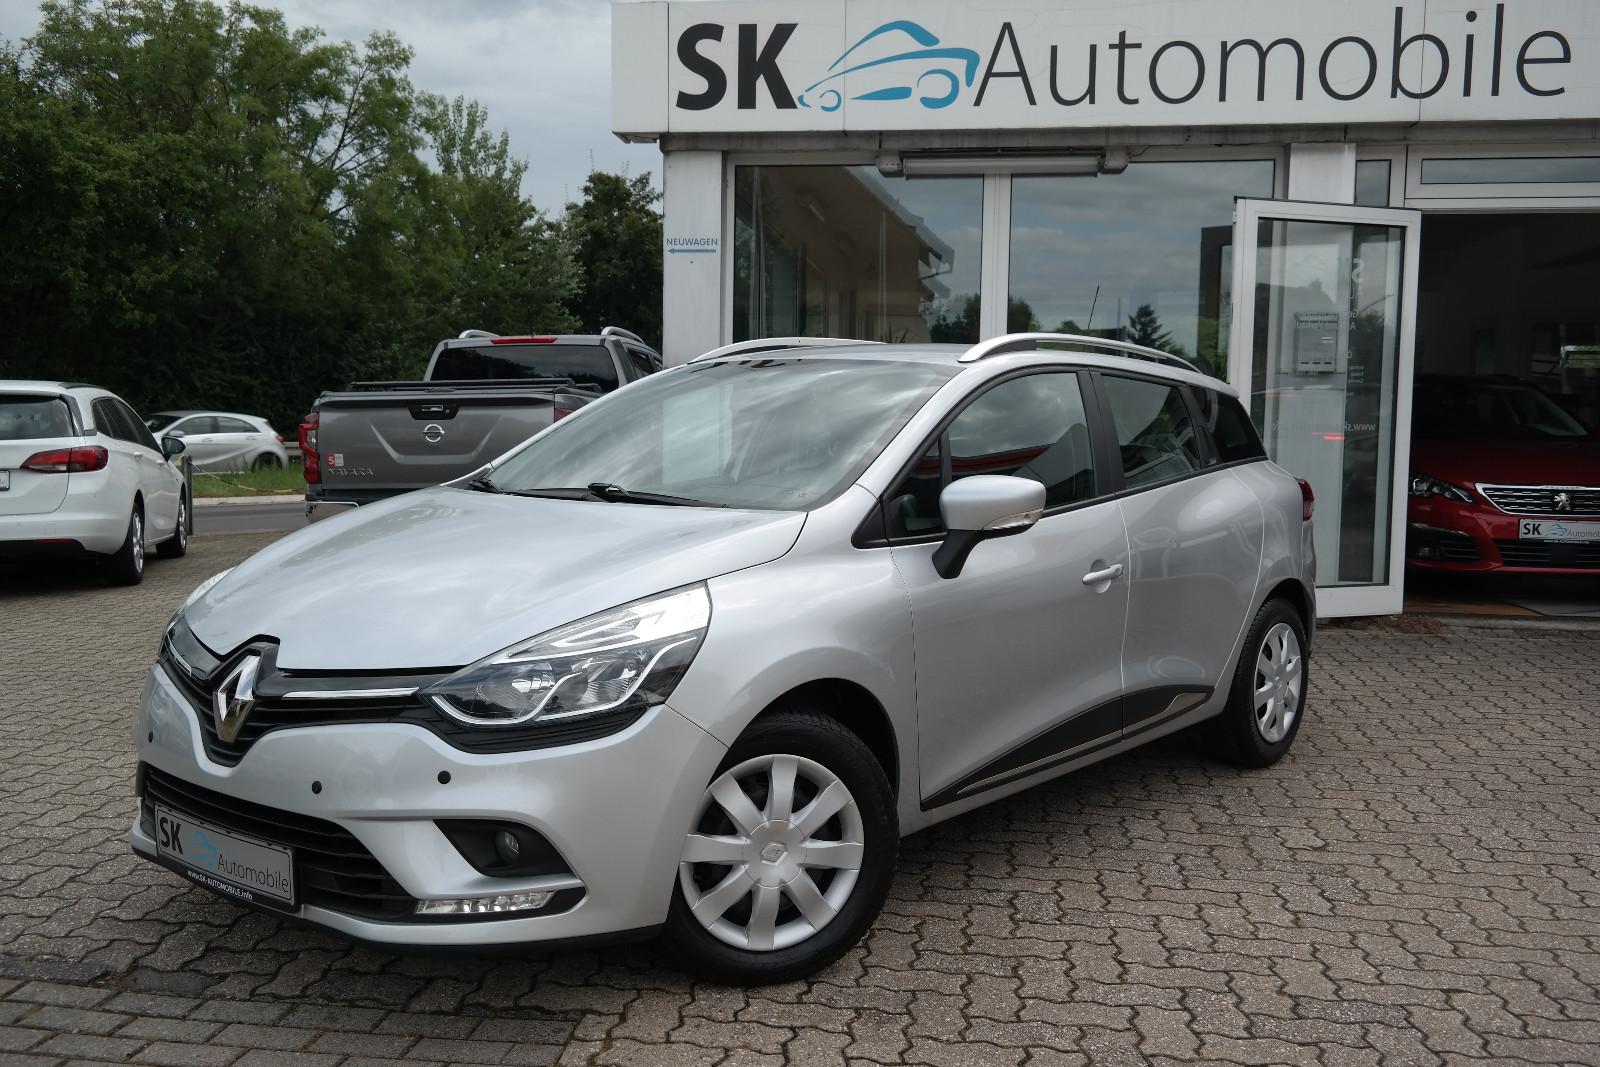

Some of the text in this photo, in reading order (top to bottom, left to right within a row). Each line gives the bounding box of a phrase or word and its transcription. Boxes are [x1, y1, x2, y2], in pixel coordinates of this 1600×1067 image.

[676, 3, 1572, 111] SK Automobile
[666, 237, 718, 246] NEUWAGEN
[1522, 522, 1542, 536] SK
[159, 816, 290, 893] SK Automobile
